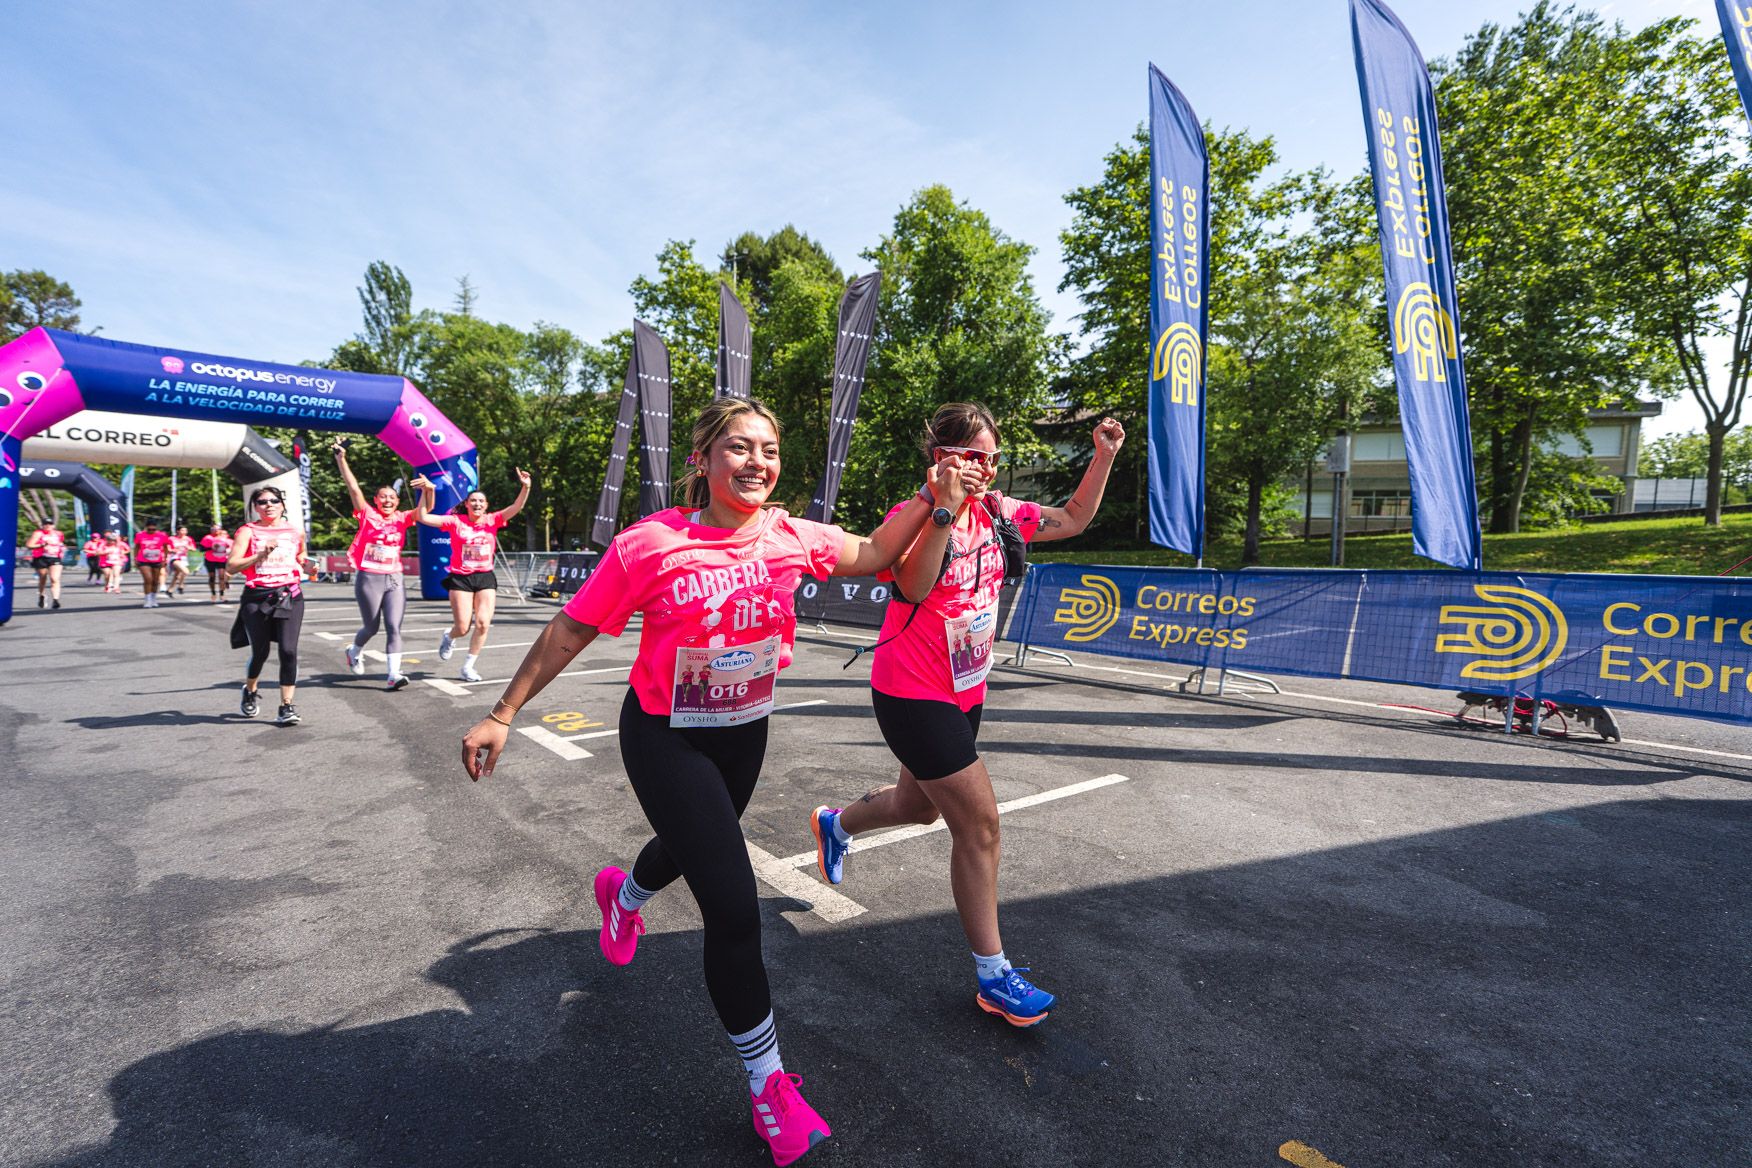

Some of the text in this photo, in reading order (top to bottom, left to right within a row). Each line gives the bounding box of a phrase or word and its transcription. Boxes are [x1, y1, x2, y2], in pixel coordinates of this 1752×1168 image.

[145, 392, 346, 421] A LA VELOCIDAD DE LA LUZ
[149, 378, 345, 410] LA ENERGÍA PARA CORRER
[66, 427, 172, 447] CORREO
[431, 537, 452, 546] octop
[733, 598, 763, 631] DE
[1136, 585, 1257, 616] Correos
[1128, 615, 1249, 649] Express
[714, 656, 753, 668] ASTURIANA
[1599, 645, 1752, 698] Expr
[709, 682, 749, 699] 016
[683, 715, 718, 723] OYSHO
